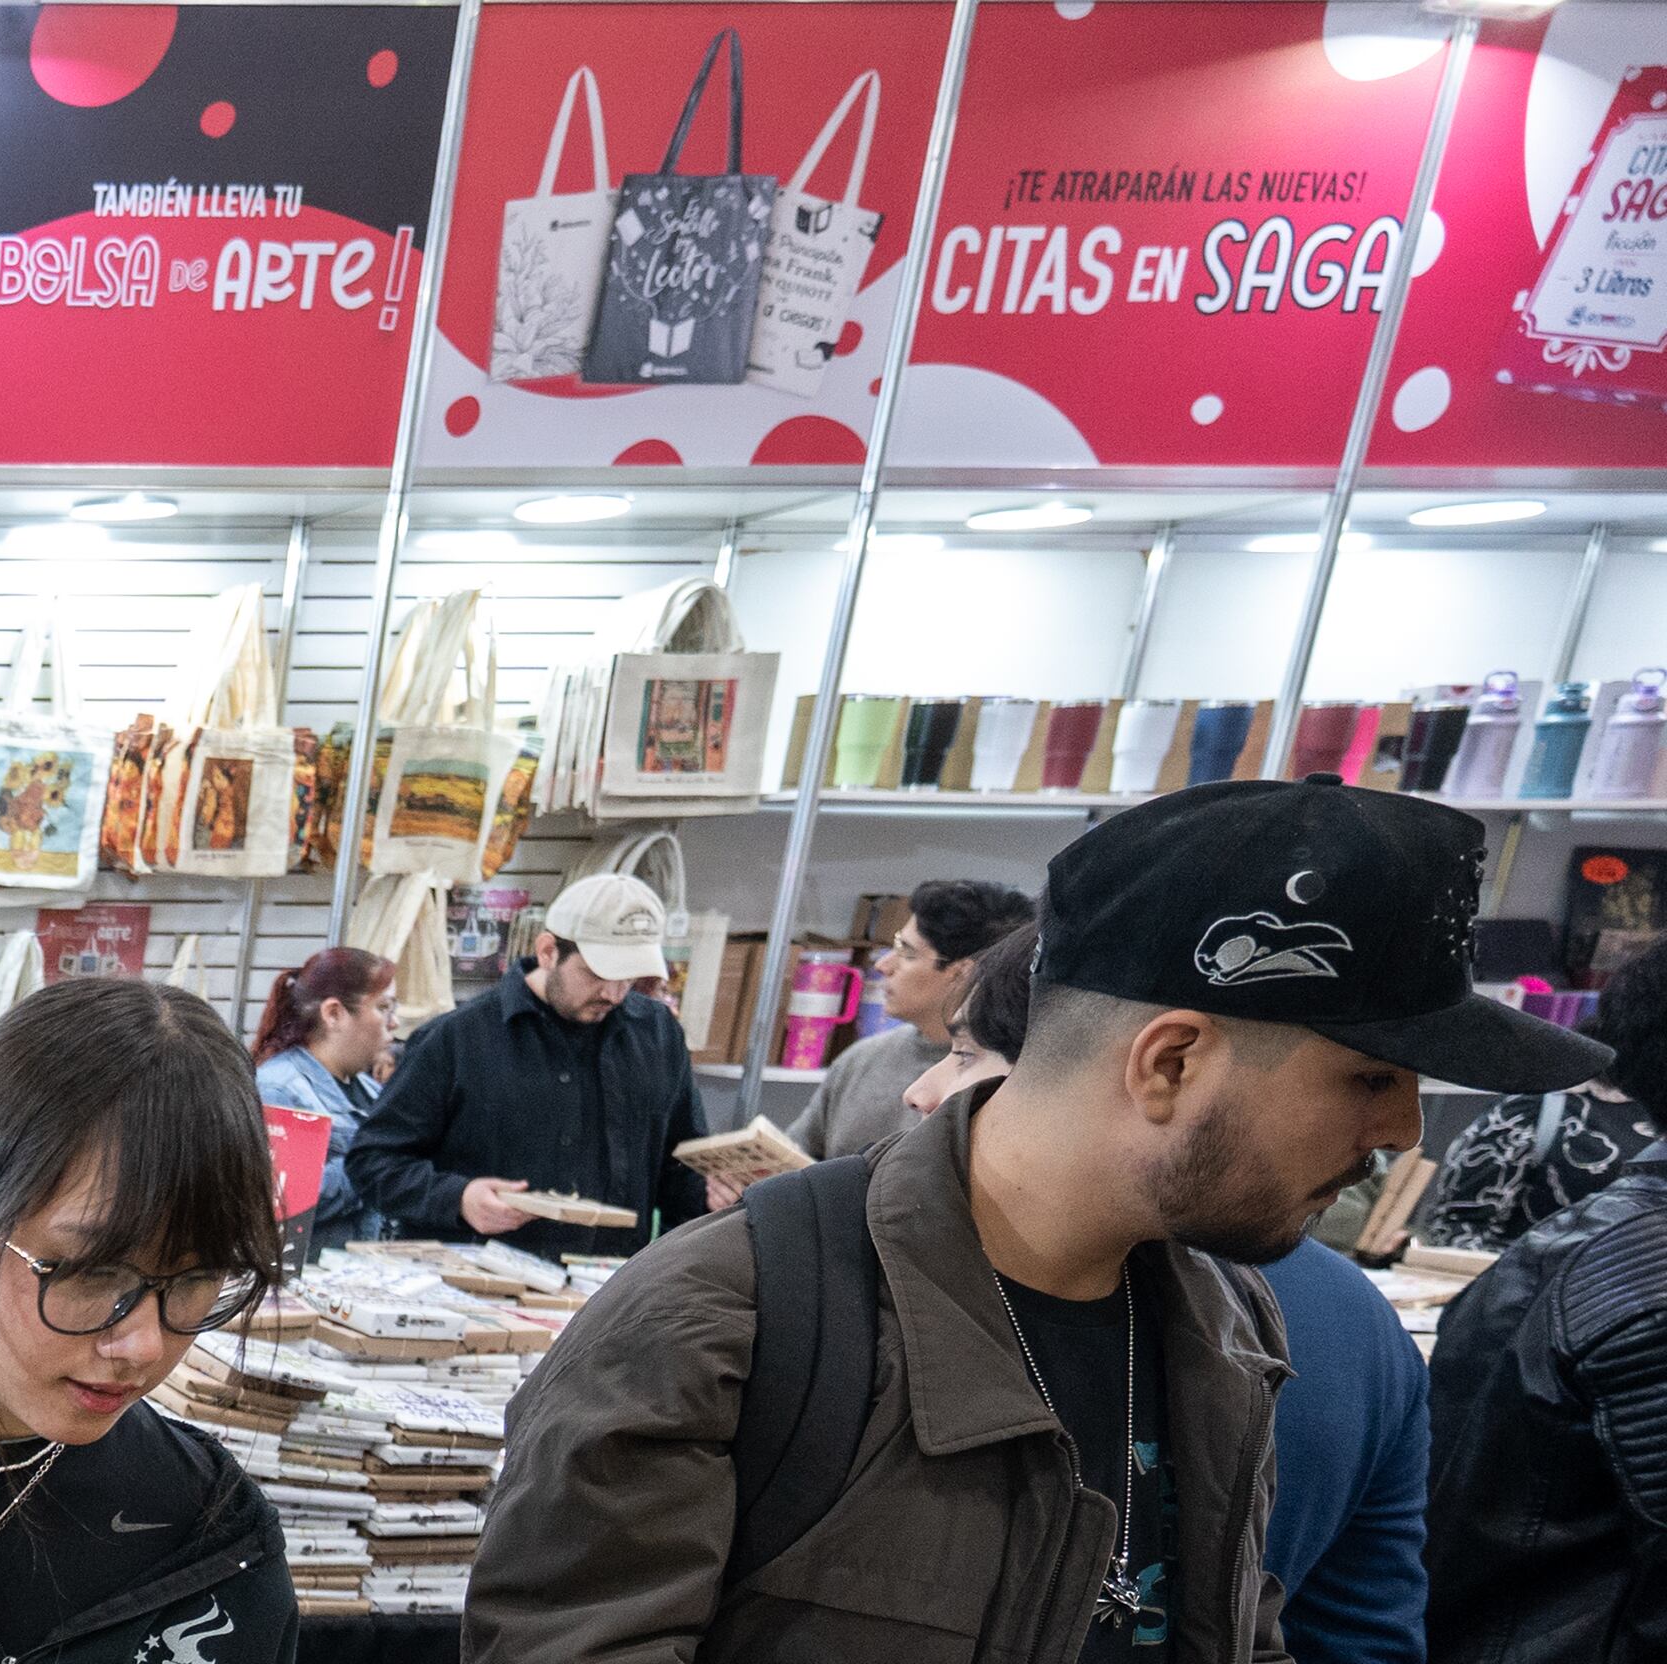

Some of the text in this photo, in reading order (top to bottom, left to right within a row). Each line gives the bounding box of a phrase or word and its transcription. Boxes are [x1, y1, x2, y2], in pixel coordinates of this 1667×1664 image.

[93, 177, 302, 218] TAMBIÉN LLEVA TU
[1050, 163, 1195, 203] ATRAPARÁN
[1201, 171, 1251, 203] LAS
[1258, 171, 1368, 203] NUEVAS!
[931, 216, 1407, 316] CITAS EN SAGA
[1574, 267, 1594, 293] 3
